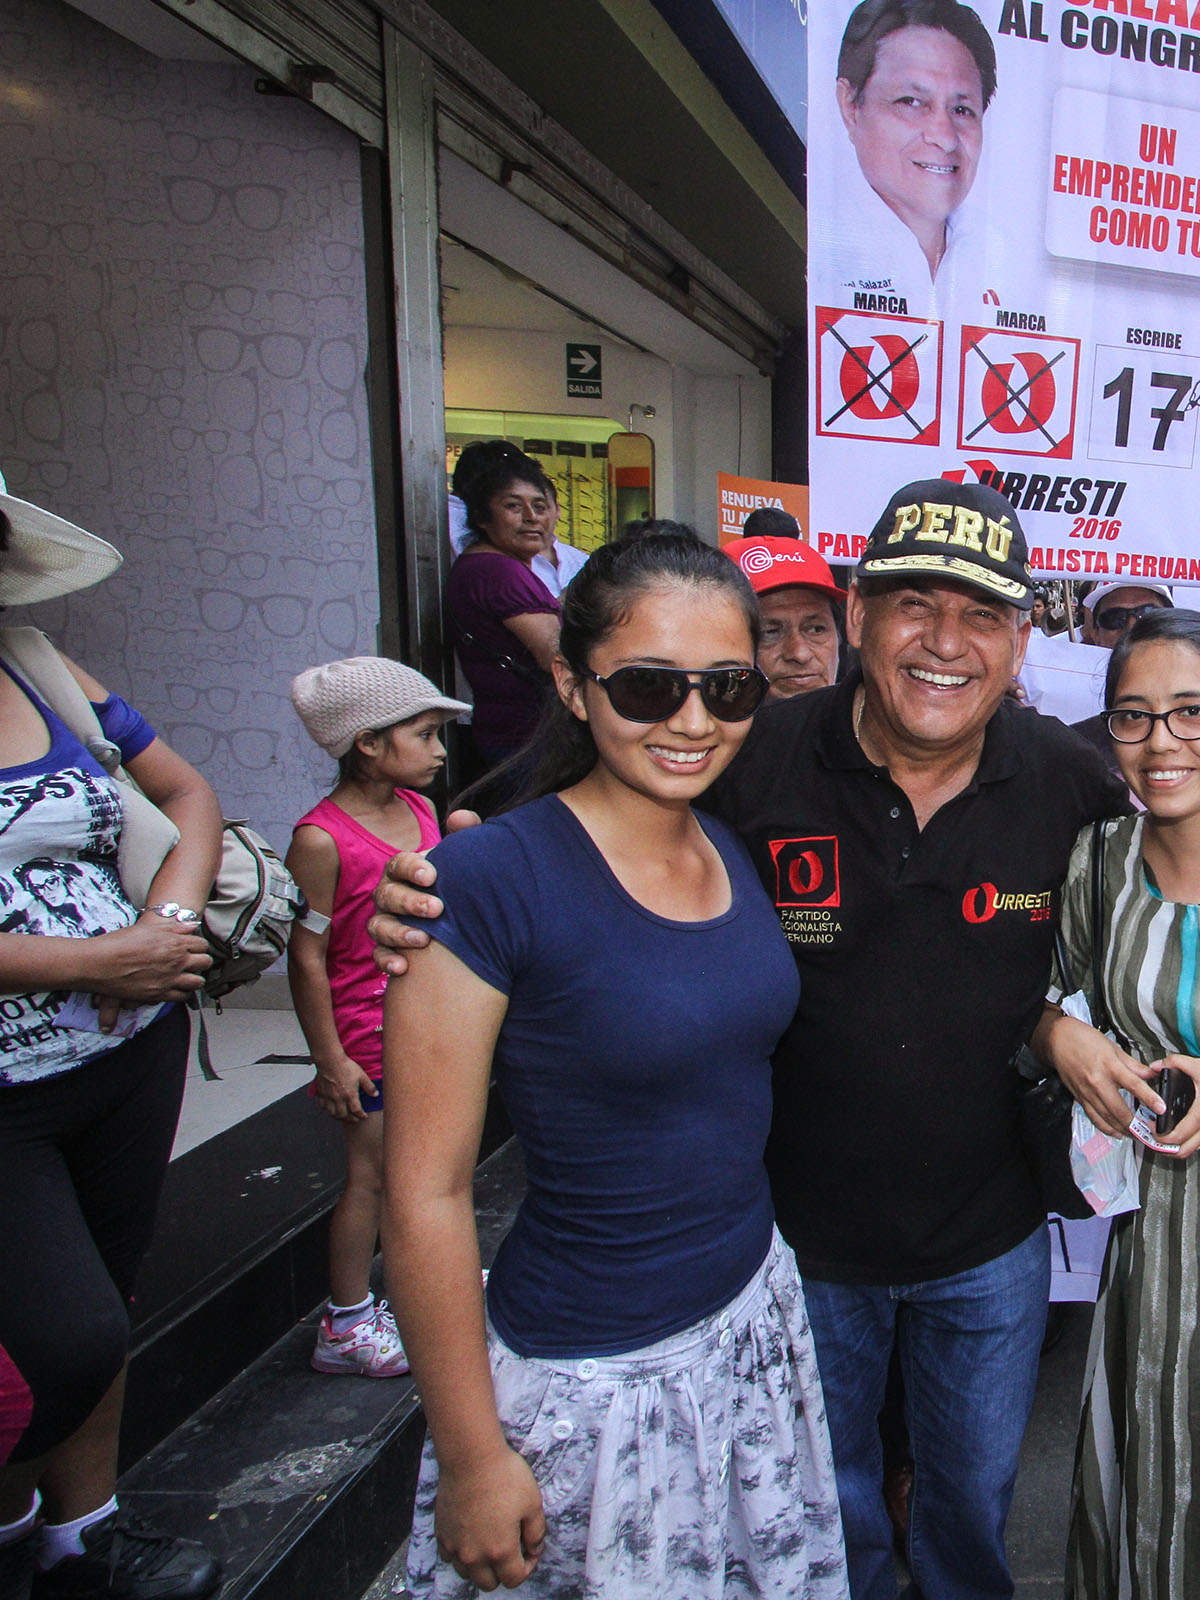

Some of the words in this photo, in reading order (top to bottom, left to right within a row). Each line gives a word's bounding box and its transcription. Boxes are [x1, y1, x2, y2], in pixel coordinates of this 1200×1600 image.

[998, 2, 1049, 43] AL
[1139, 124, 1177, 166] UN
[1089, 205, 1167, 253] COMO
[853, 291, 909, 315] MARCA
[996, 310, 1047, 333] MARCA
[1126, 327, 1182, 350] ESCRIBE
[568, 384, 601, 394] SALIDA
[1103, 367, 1193, 451] 17
[722, 489, 784, 511] RENUEVA
[722, 508, 736, 523] TU
[887, 503, 1013, 562] PERÚ
[1069, 517, 1122, 541] 2016
[781, 911, 831, 920] PARTIDO
